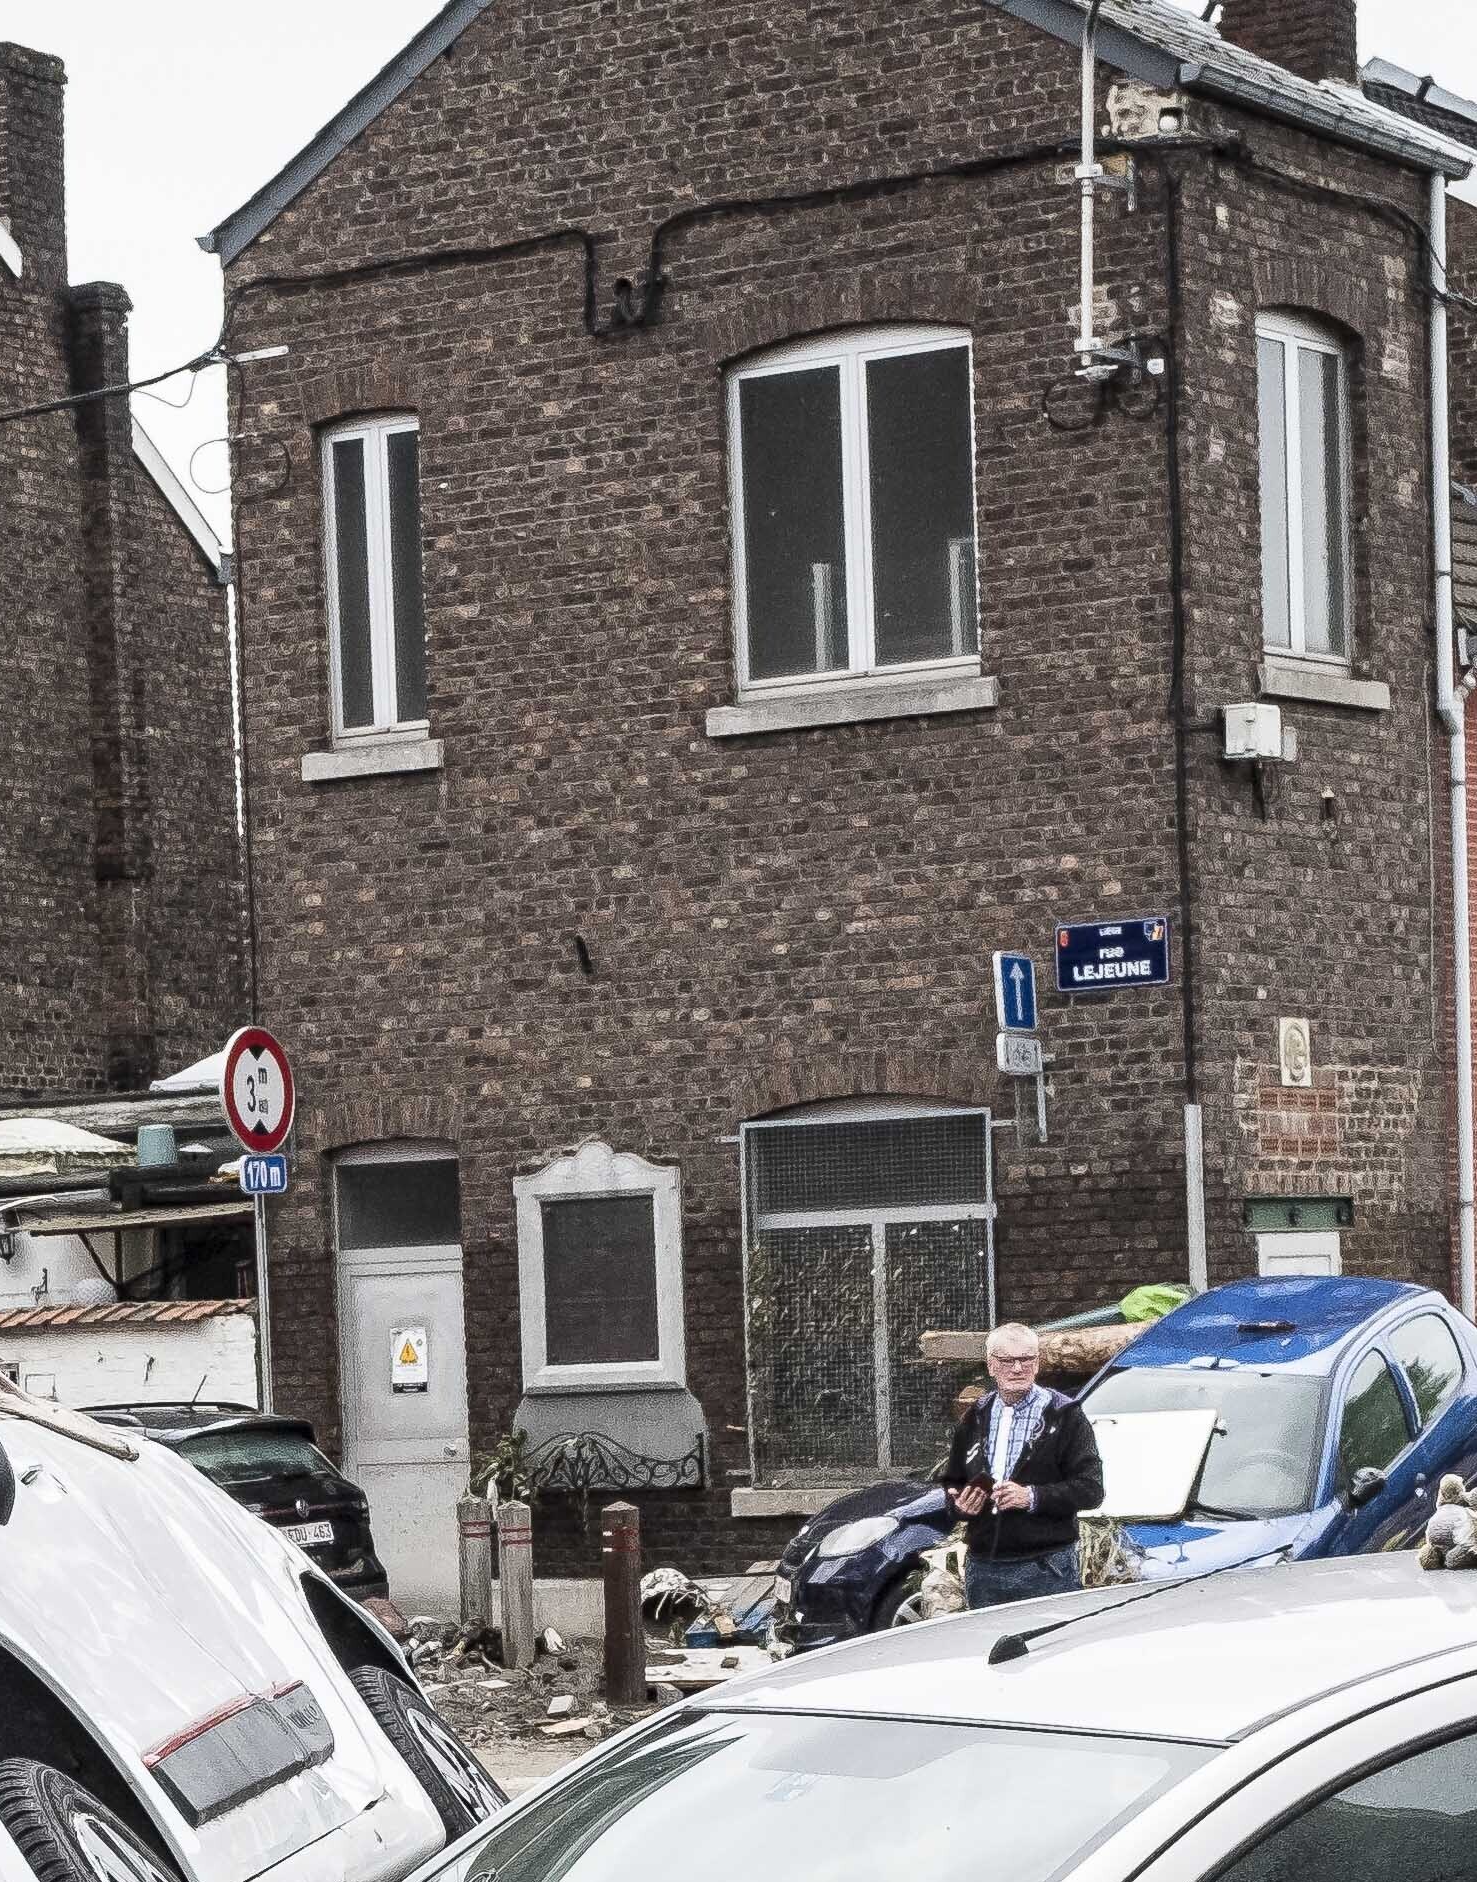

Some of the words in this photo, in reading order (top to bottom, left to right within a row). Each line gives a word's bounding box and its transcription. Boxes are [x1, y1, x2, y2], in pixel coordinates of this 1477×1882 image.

[1072, 959, 1152, 982] LEJEUNE
[246, 1074, 257, 1113] 3
[246, 1160, 268, 1190] 170
[269, 1166, 281, 1188] m
